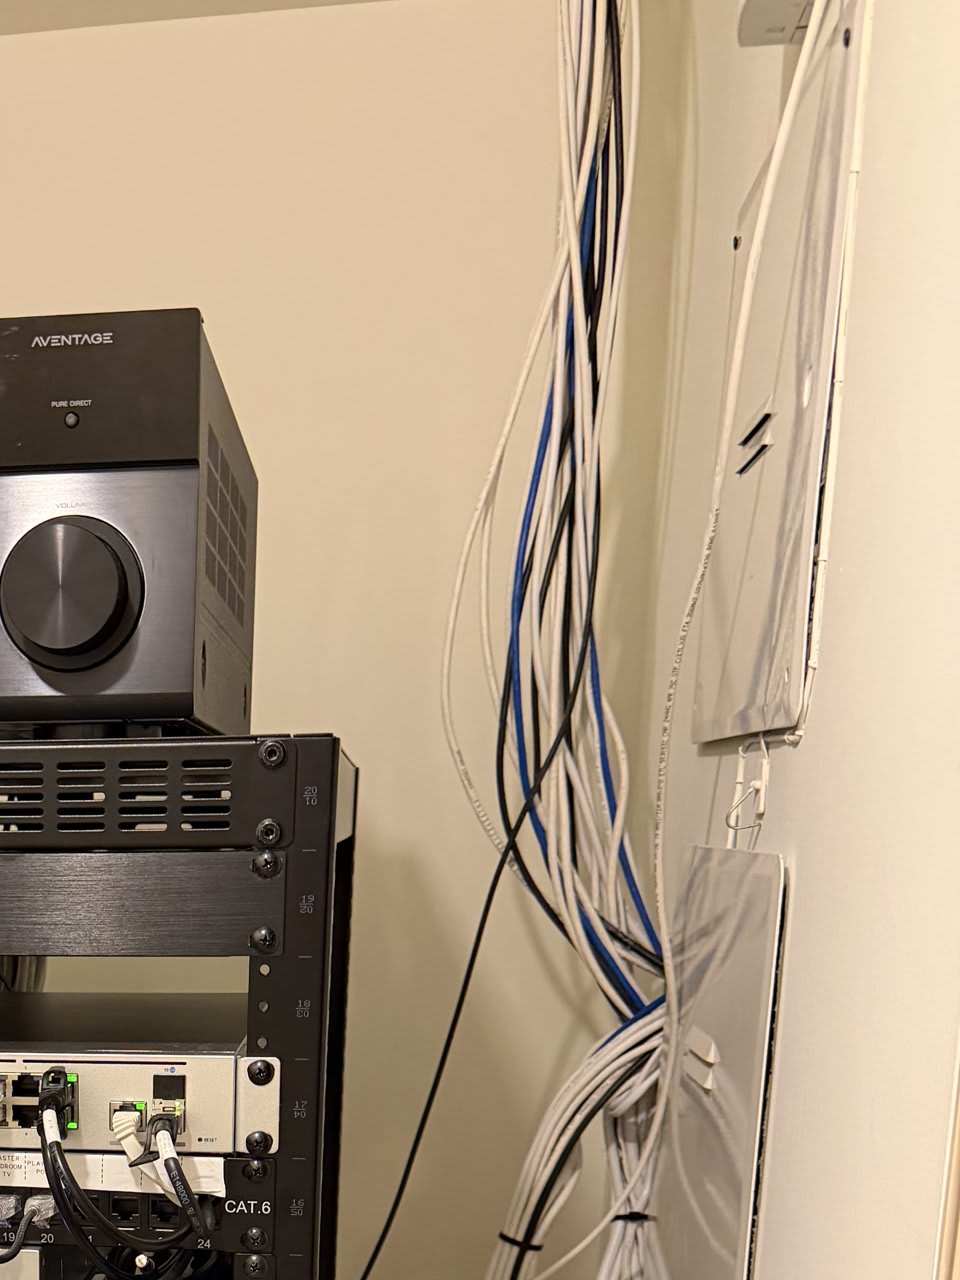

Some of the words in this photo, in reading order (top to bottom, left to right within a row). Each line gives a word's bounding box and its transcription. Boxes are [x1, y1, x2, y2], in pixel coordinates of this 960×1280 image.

[31, 332, 113, 349] AVENTAGE
[51, 400, 68, 409] PURE
[69, 399, 92, 408] DIRECT
[224, 1200, 271, 1214] CAT.6
[2, 1232, 15, 1243] 19
[40, 1233, 55, 1244] 20
[197, 1238, 211, 1249] 24
